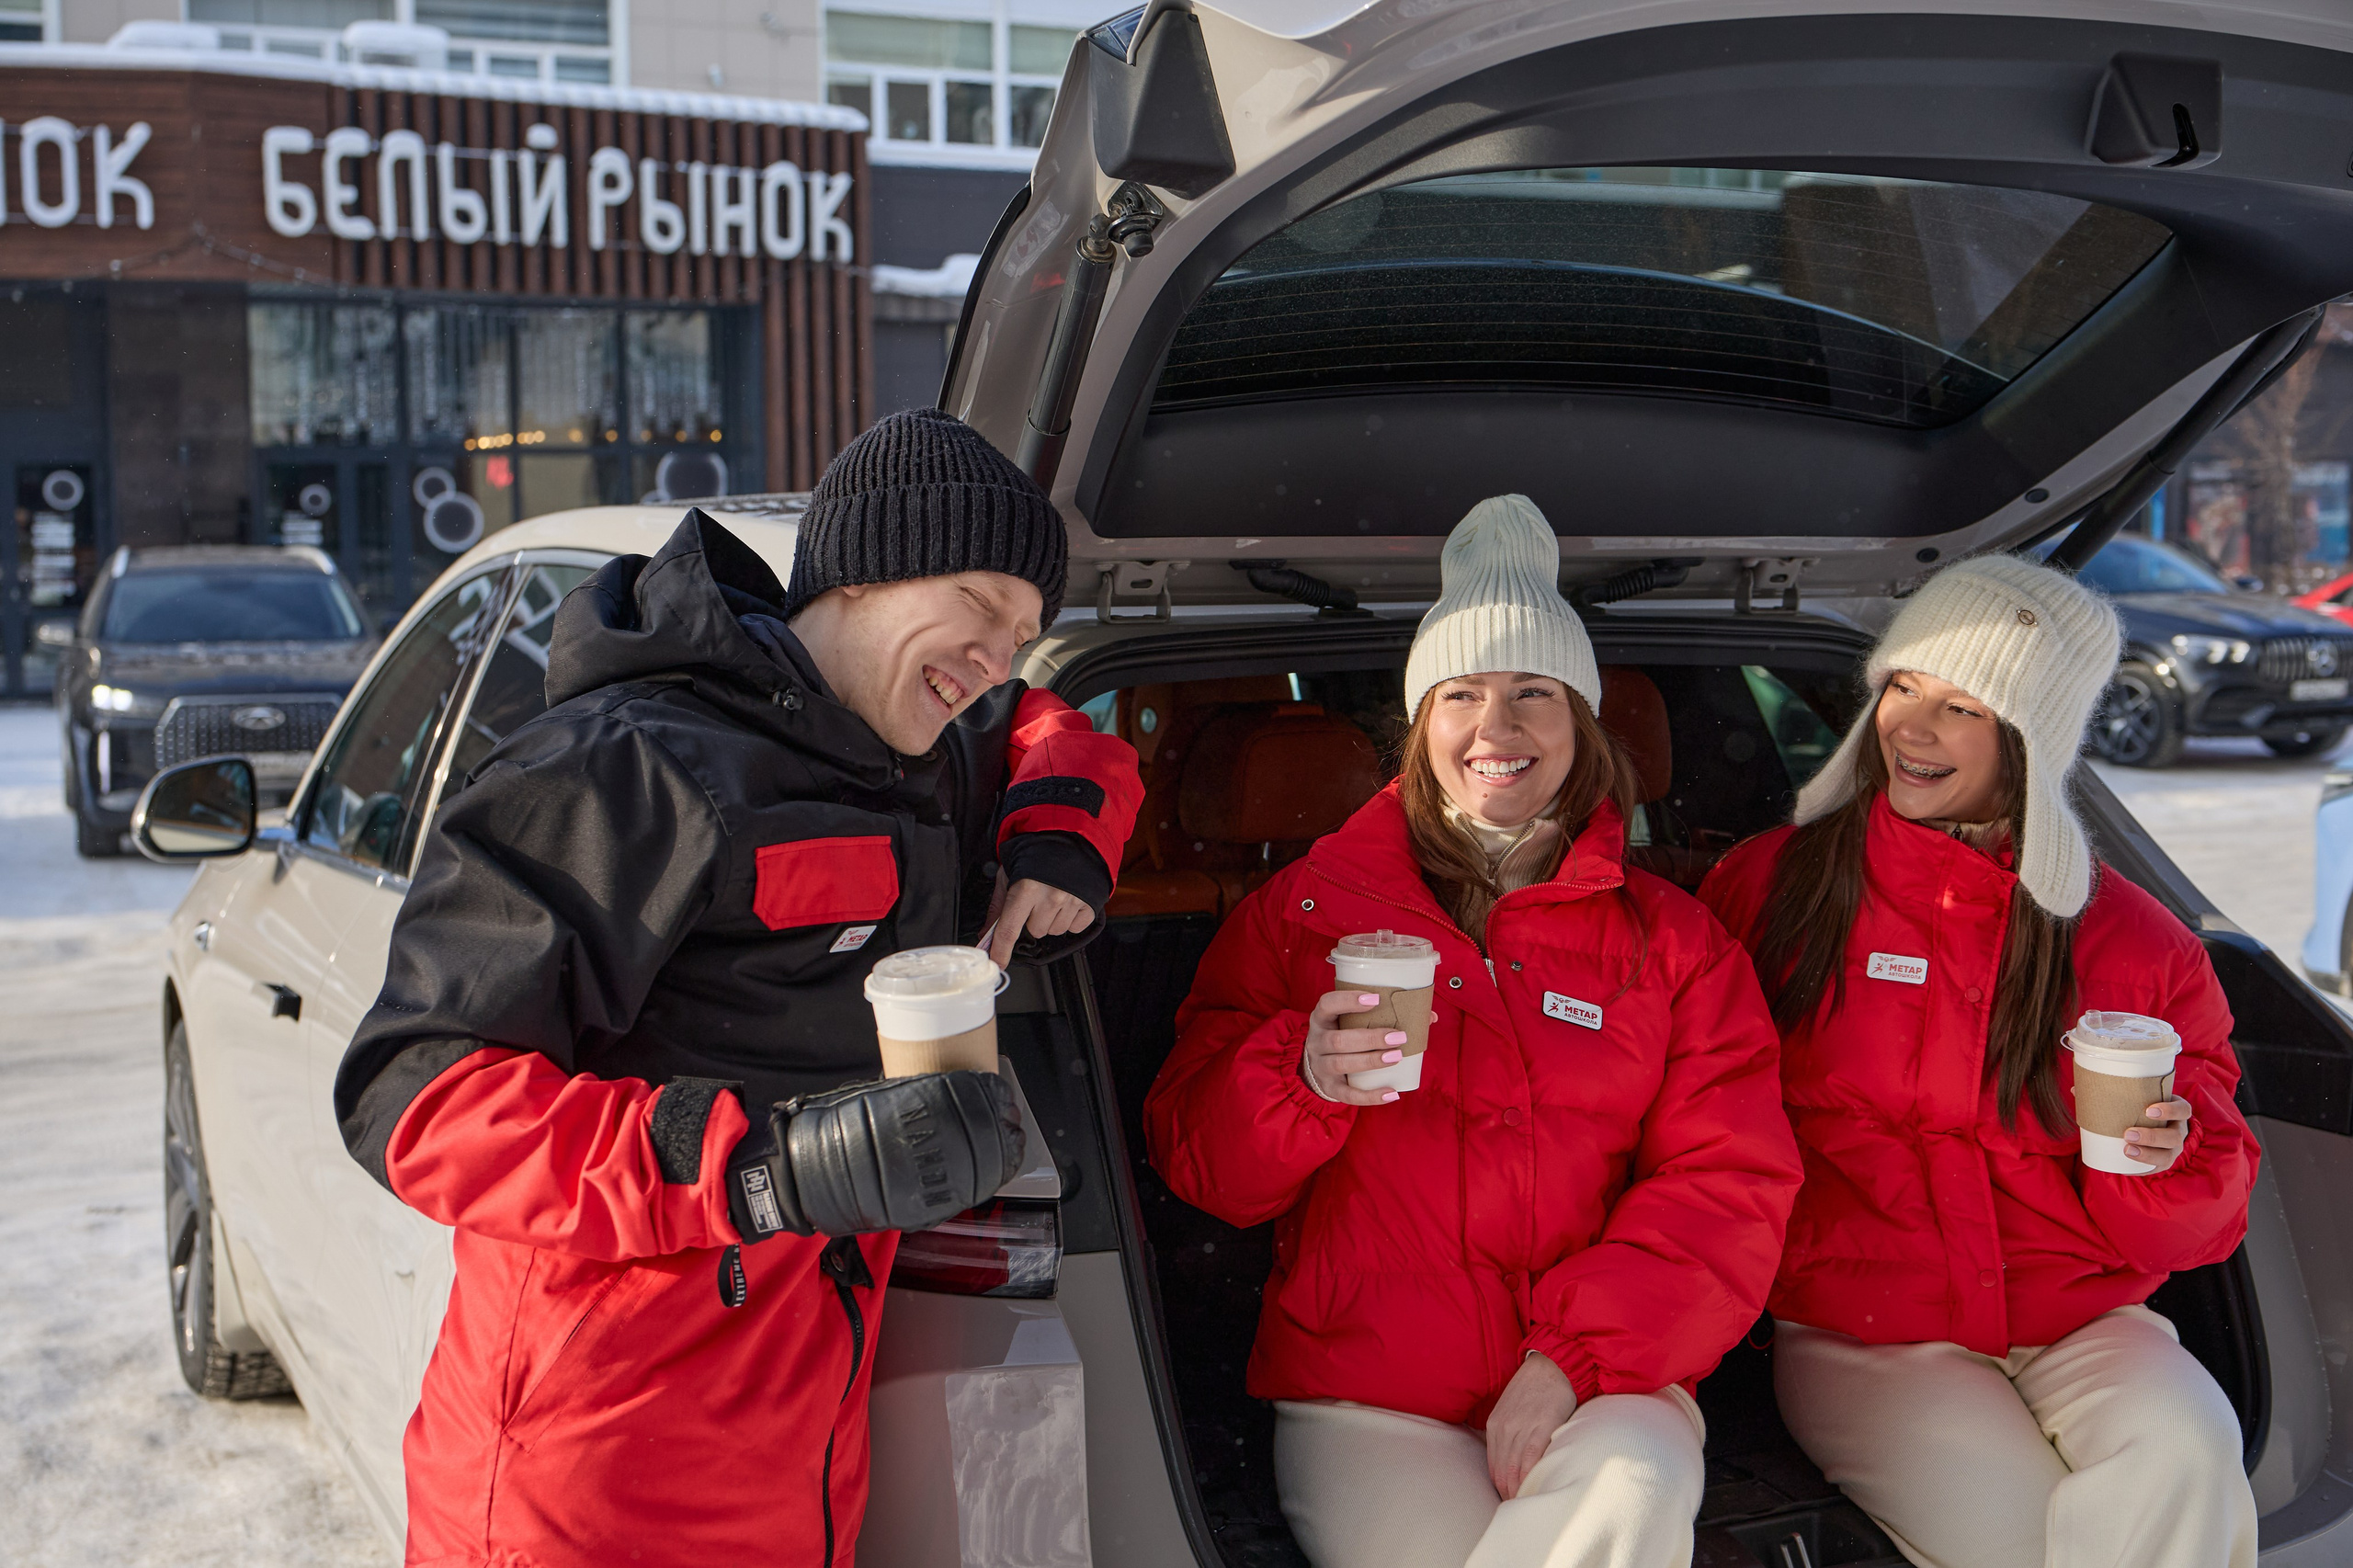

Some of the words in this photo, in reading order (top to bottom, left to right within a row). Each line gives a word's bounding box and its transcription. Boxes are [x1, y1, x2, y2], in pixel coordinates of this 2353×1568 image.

[0, 116, 154, 230] ОК
[262, 123, 568, 249] БЕЛЫЙ
[587, 146, 854, 264] РЫНОК
[1889, 963, 1923, 974] МЕТАР
[1888, 971, 1921, 980] АВТОШКОЛА
[1564, 1006, 1597, 1019] МЕТАР
[1564, 1013, 1597, 1025] АВТОШКОЛА
[733, 1258, 745, 1301] EXTREME
